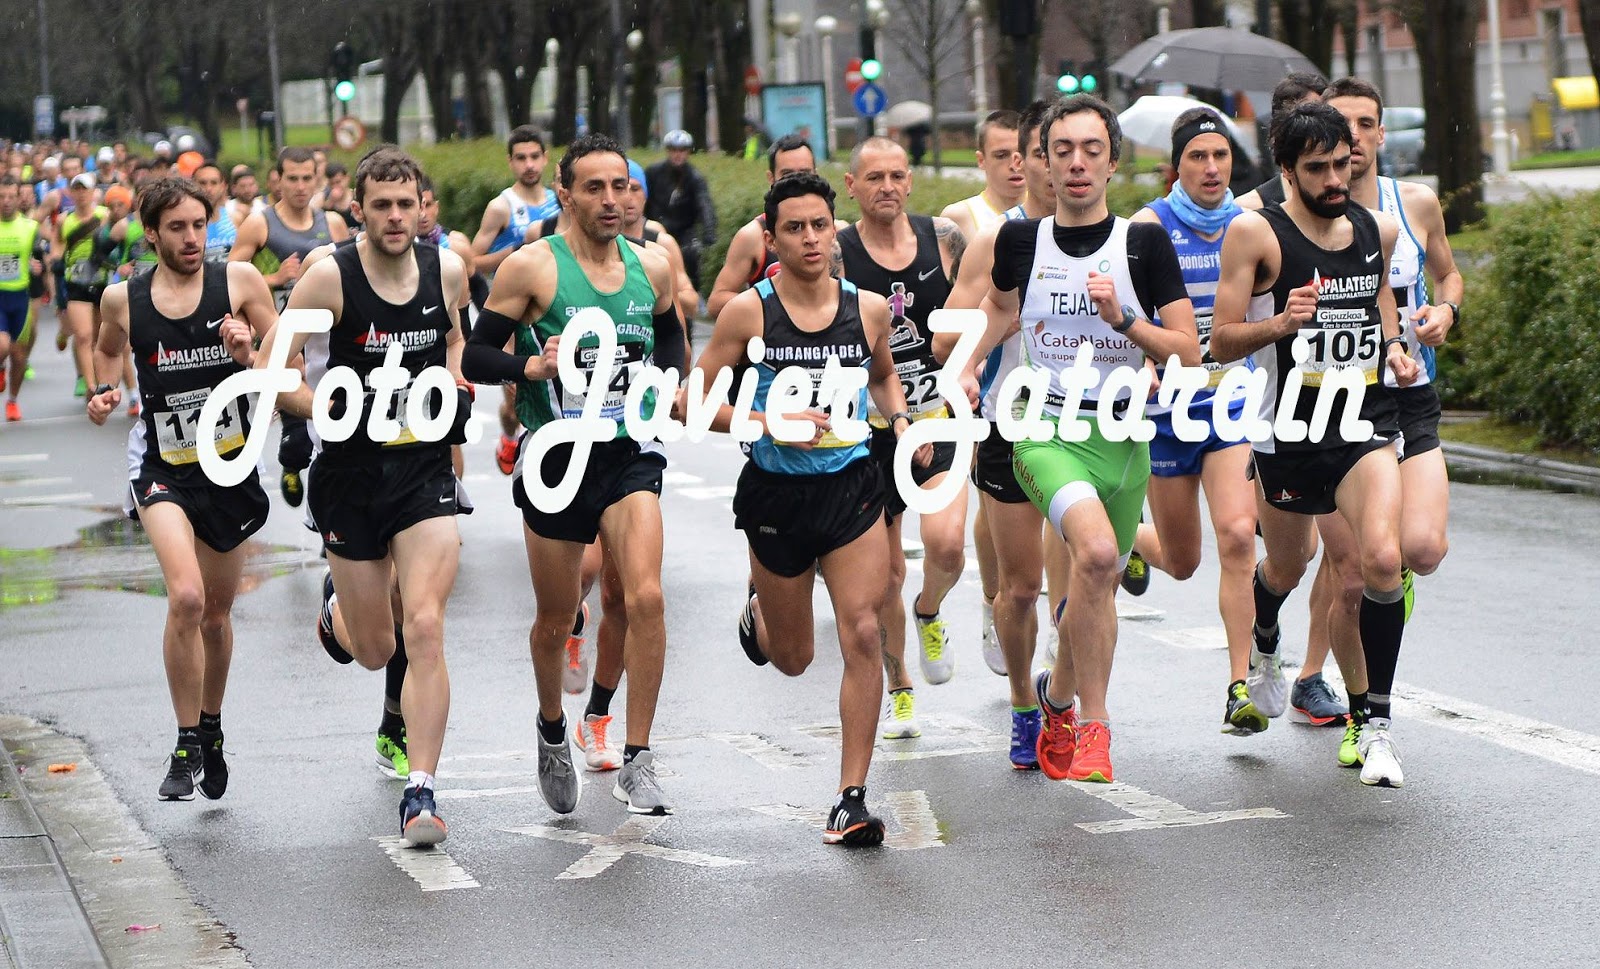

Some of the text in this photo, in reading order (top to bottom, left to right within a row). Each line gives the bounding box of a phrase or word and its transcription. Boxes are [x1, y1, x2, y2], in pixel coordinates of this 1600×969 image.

[1320, 311, 1362, 321] Gipuzkoa
[1042, 332, 1137, 349] CataNatura
[1308, 327, 1376, 363] 105
[157, 340, 232, 366] APALATEGU
[766, 343, 863, 360] DURANGALDEA
[1039, 351, 1128, 364] Tu supe ológico
